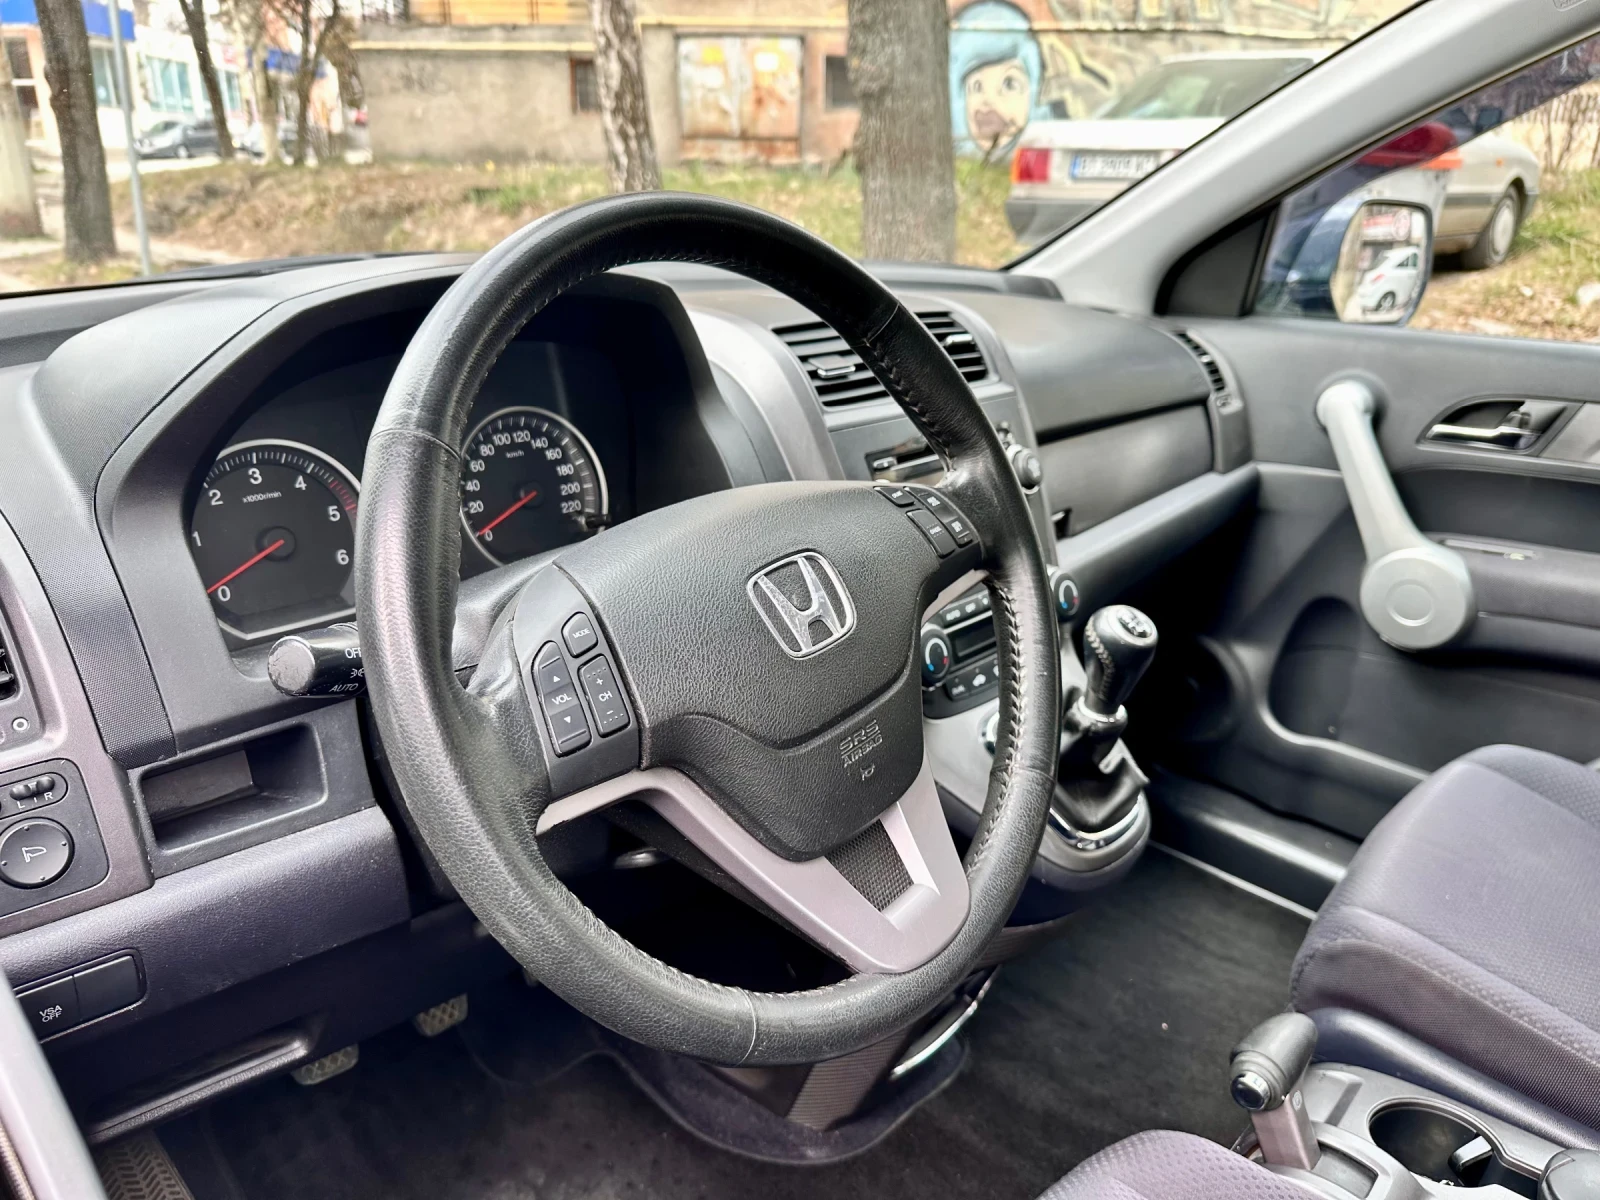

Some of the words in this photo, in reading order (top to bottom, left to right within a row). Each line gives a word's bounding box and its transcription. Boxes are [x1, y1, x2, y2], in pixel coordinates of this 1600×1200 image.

[492, 432, 511, 446] 100
[512, 430, 531, 442] 120
[531, 437, 548, 449] 140
[480, 444, 494, 456] 80
[545, 448, 562, 460] 160
[470, 460, 485, 472] 60
[556, 464, 574, 476] 180
[248, 467, 263, 484] 3
[294, 475, 307, 491] 4
[466, 479, 480, 492] 40
[560, 482, 580, 496] 200
[209, 489, 223, 505] 2
[469, 500, 484, 513] 20
[561, 501, 581, 514] 220
[328, 505, 340, 521] 5
[192, 531, 202, 547] 1
[484, 530, 493, 541] 0
[337, 549, 349, 565] 6
[217, 585, 231, 602] 0
[329, 683, 358, 693] AUTO
[552, 693, 572, 705] VOL
[598, 691, 613, 702] CH
[840, 719, 879, 755] SRS
[843, 733, 883, 769] AIRBAG
[44, 791, 53, 801] R
[16, 800, 25, 809] L
[39, 1005, 62, 1016] VSA
[41, 1011, 62, 1022] OFF
